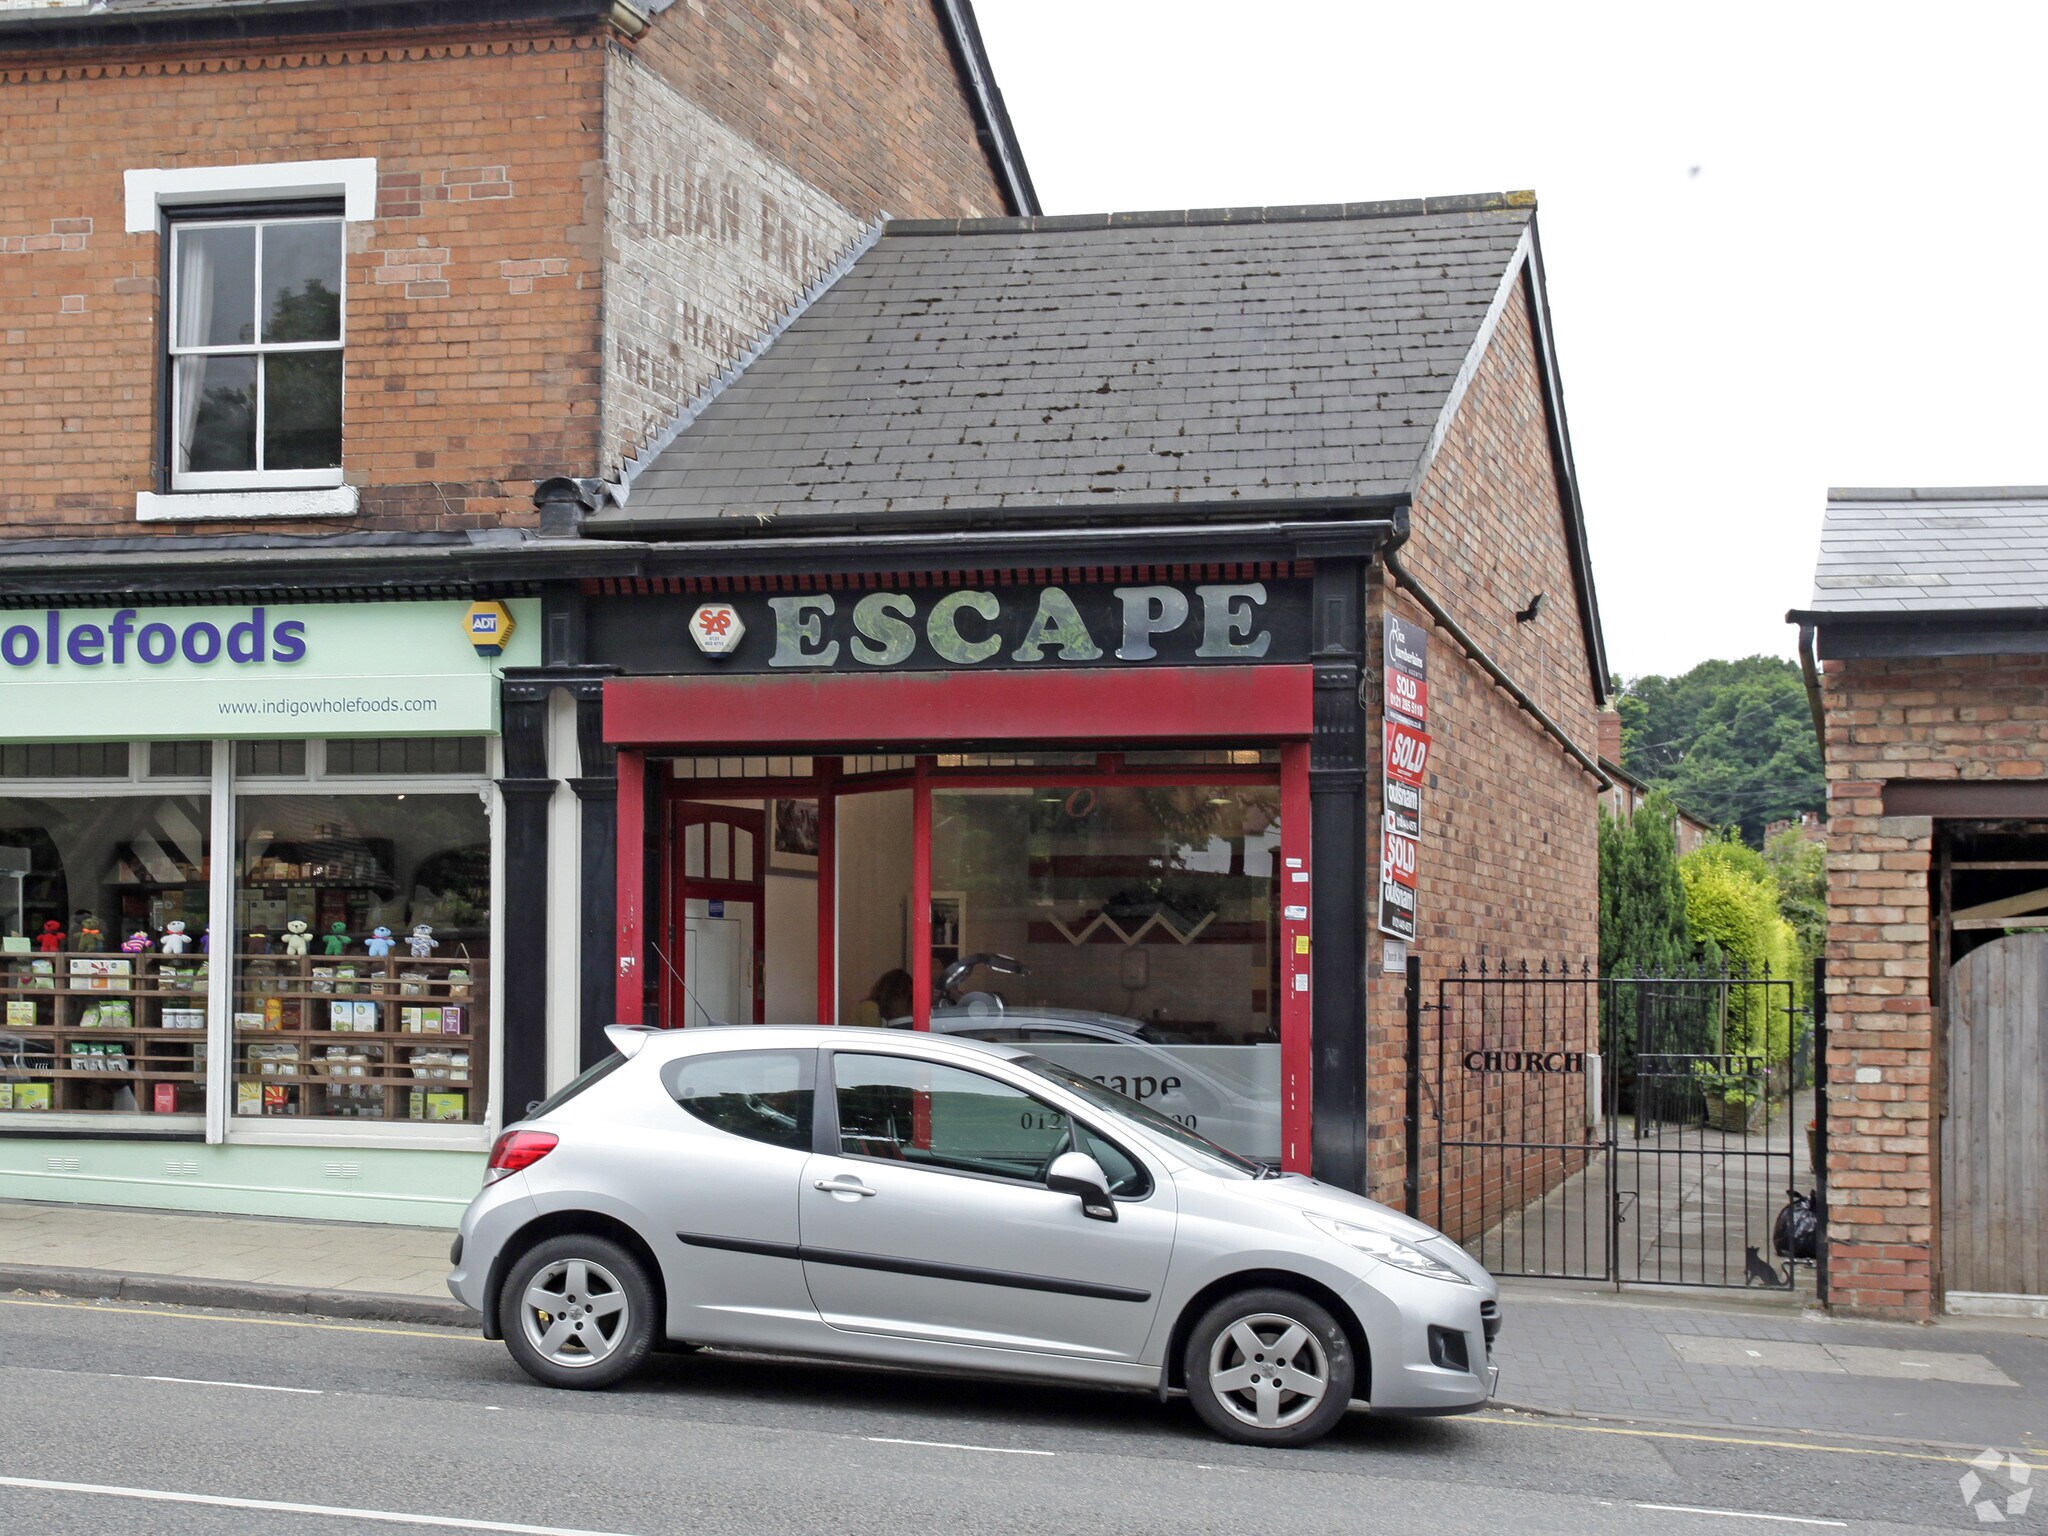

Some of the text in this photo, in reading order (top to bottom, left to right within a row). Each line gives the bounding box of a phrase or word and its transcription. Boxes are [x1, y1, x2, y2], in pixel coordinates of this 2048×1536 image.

[472, 617, 497, 629] ADT
[699, 609, 731, 636] SAS
[768, 582, 1271, 668] ESCAPE
[1, 607, 306, 666] olefoods
[1396, 673, 1417, 700] SOLD
[218, 697, 437, 717] www.indigowholefoods.com
[1392, 732, 1427, 774] SOLD
[1387, 833, 1415, 874] SOLD
[1465, 1051, 1584, 1073] CHURCH
